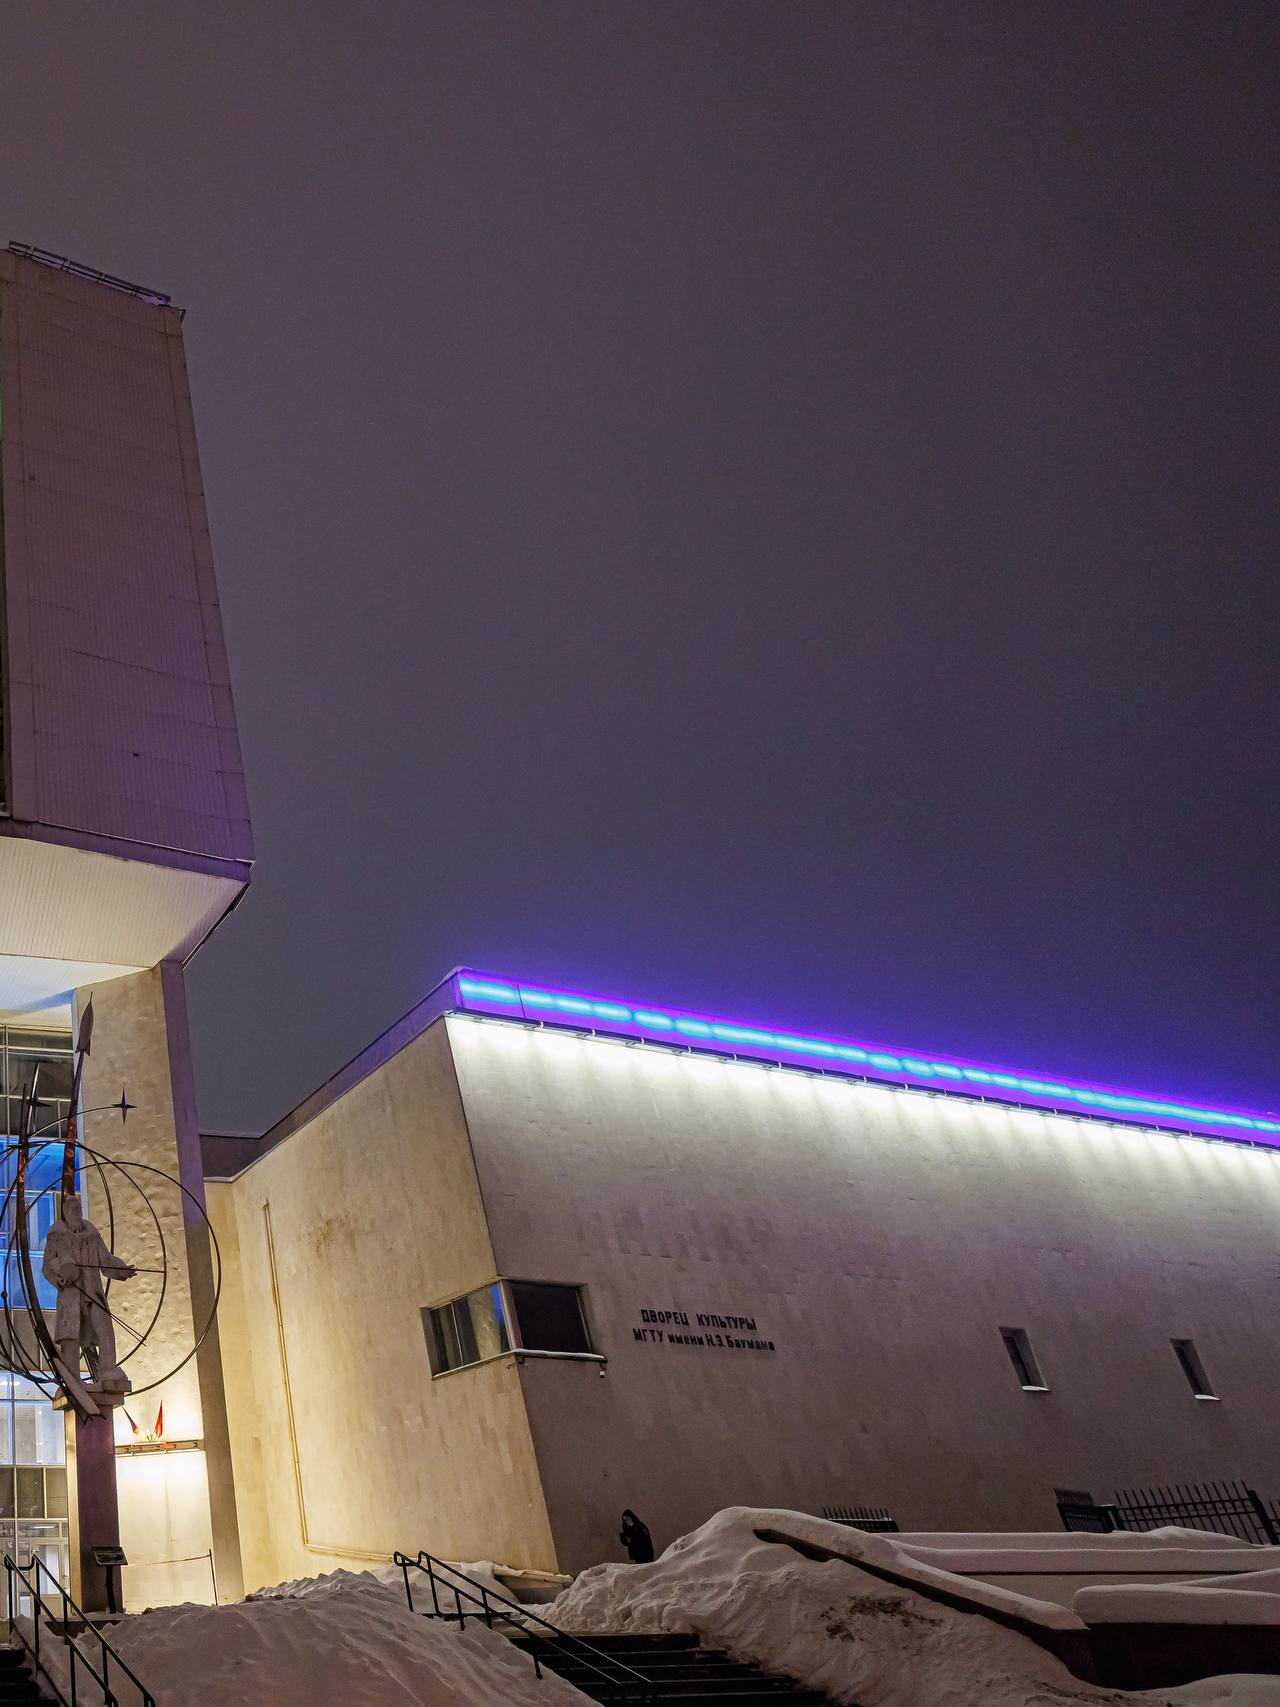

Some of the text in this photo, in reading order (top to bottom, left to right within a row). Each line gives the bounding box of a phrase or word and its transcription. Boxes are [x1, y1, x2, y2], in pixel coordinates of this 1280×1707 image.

[640, 1309, 757, 1330] ДВОРЕЦ КУЛЬТУРЫ
[632, 1328, 663, 1342] МГТУ
[668, 1334, 704, 1345] имени
